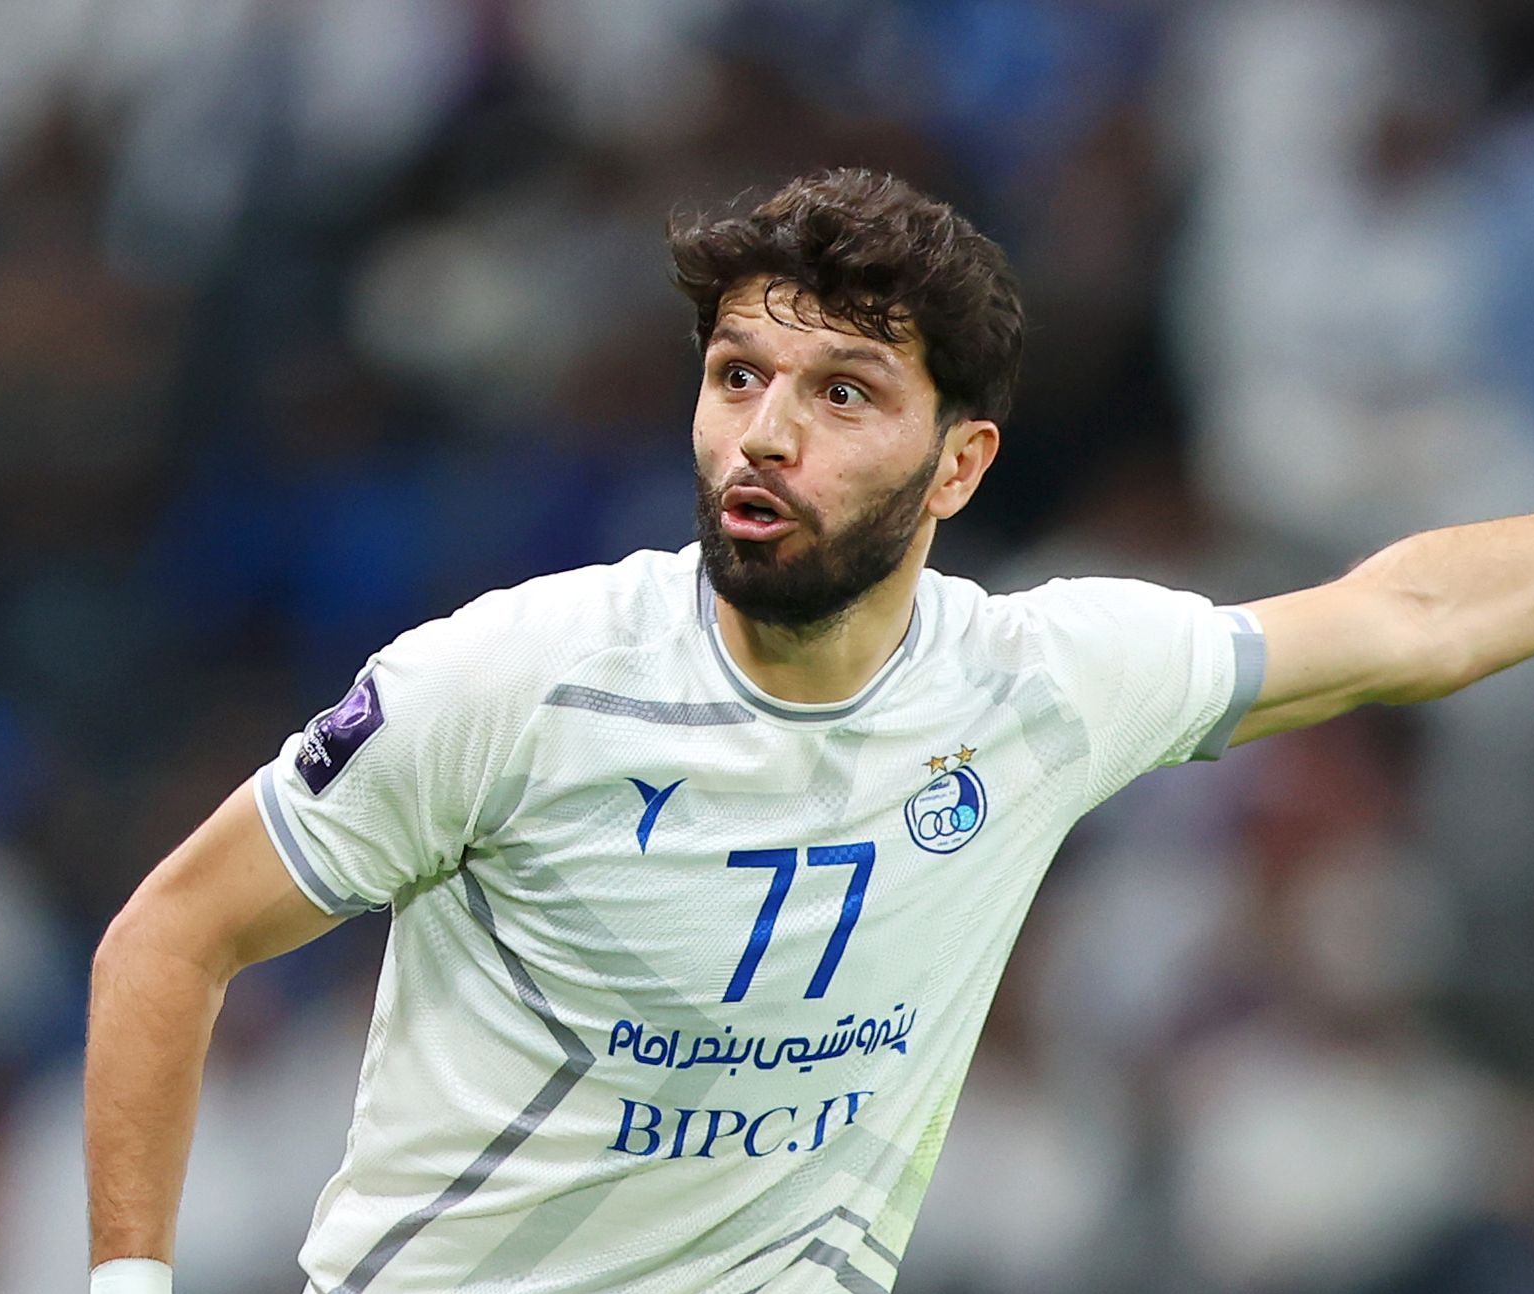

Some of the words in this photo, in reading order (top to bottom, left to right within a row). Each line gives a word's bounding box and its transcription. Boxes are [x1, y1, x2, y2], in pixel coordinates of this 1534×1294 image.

[721, 841, 876, 1003] 77
[608, 1019, 680, 1069] امام
[676, 1025, 754, 1076] بندر
[753, 1002, 917, 1074] پتروشیمی
